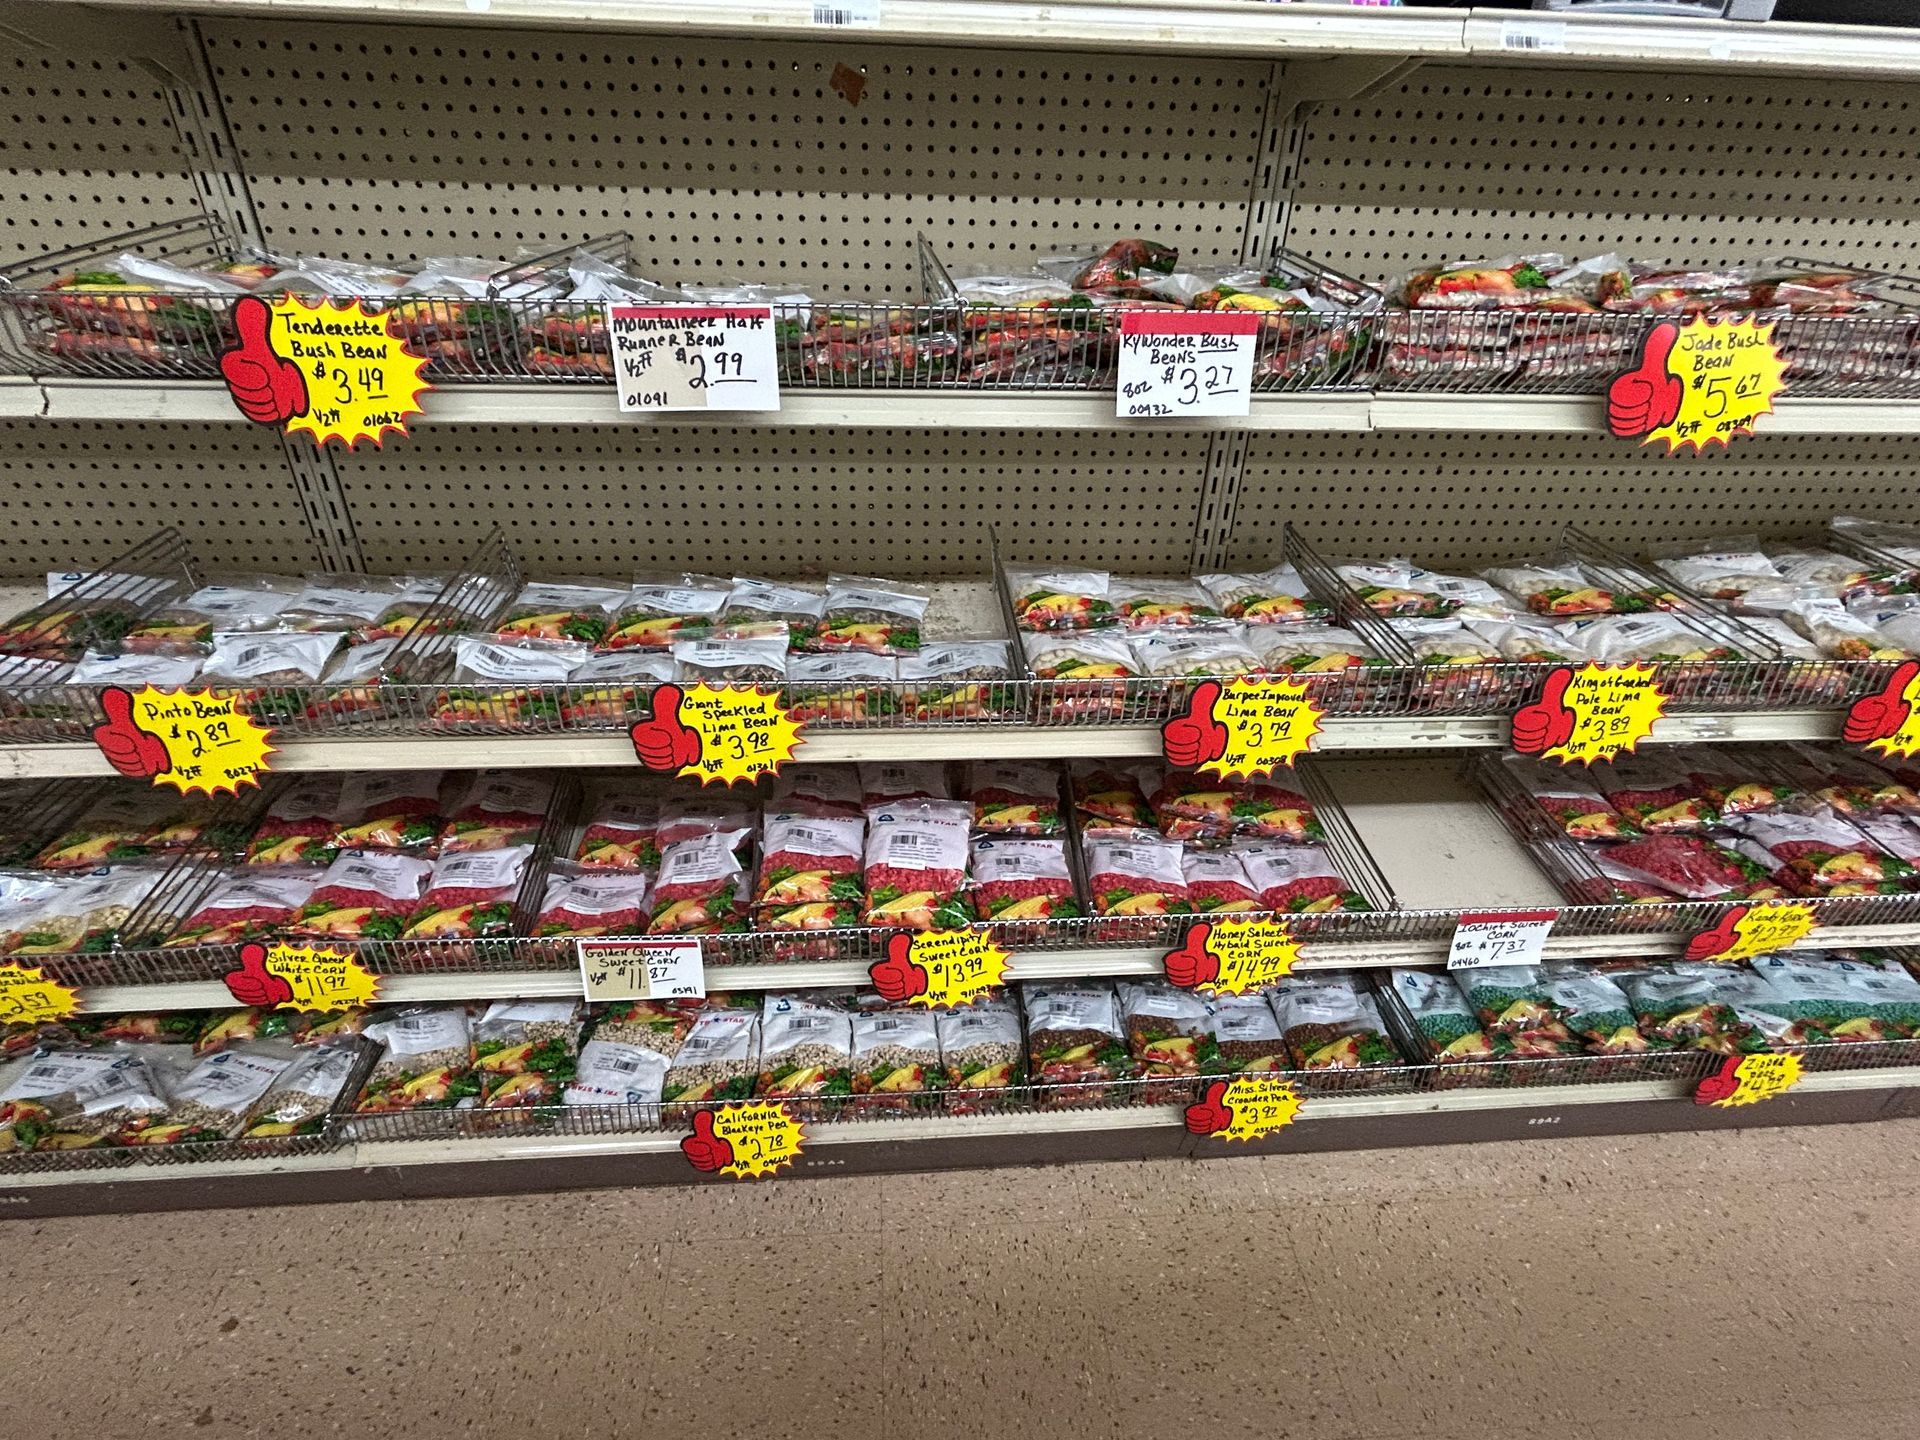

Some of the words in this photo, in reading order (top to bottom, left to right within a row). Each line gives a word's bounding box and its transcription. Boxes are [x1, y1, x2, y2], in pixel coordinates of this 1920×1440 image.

[612, 314, 717, 333] Mountaineer
[726, 313, 764, 330] Half
[617, 333, 680, 351] Runner
[685, 331, 725, 348] Bean
[1200, 333, 1239, 348] Bush
[1682, 333, 1722, 351] Jade
[1727, 332, 1765, 349] Bush
[291, 340, 335, 358] Bush
[341, 341, 387, 360] Bean
[1150, 349, 1196, 364] Beans
[1693, 354, 1735, 371] Bean
[627, 392, 668, 406] 01091
[1129, 404, 1173, 416] 00932
[1573, 676, 1598, 691] King
[1600, 675, 1612, 687] of
[1223, 688, 1259, 704] Burpee
[1576, 693, 1600, 705] Pole
[1608, 692, 1640, 702] Lima
[684, 697, 723, 710] Giant
[143, 702, 191, 720] Pinto
[192, 701, 232, 718] Bean
[1226, 704, 1256, 717] Lima
[1264, 706, 1298, 718] Bean
[1592, 705, 1624, 716] Bean
[743, 715, 779, 729] Bean
[1213, 928, 1246, 940] Honey
[1247, 927, 1284, 938] Select
[913, 934, 982, 950] Serendipity
[1213, 939, 1250, 951] Hybrid
[1254, 938, 1290, 948] Sweet
[268, 951, 309, 963] Silver
[585, 947, 629, 959] Golden
[632, 947, 677, 957] Queen
[920, 949, 957, 962] Sweet
[599, 958, 644, 967] Sweet
[273, 965, 311, 974] White
[1259, 1082, 1289, 1091] Silver
[1271, 1094, 1290, 1102] Pea
[716, 1111, 780, 1124] California
[768, 1121, 789, 1130] Pea
